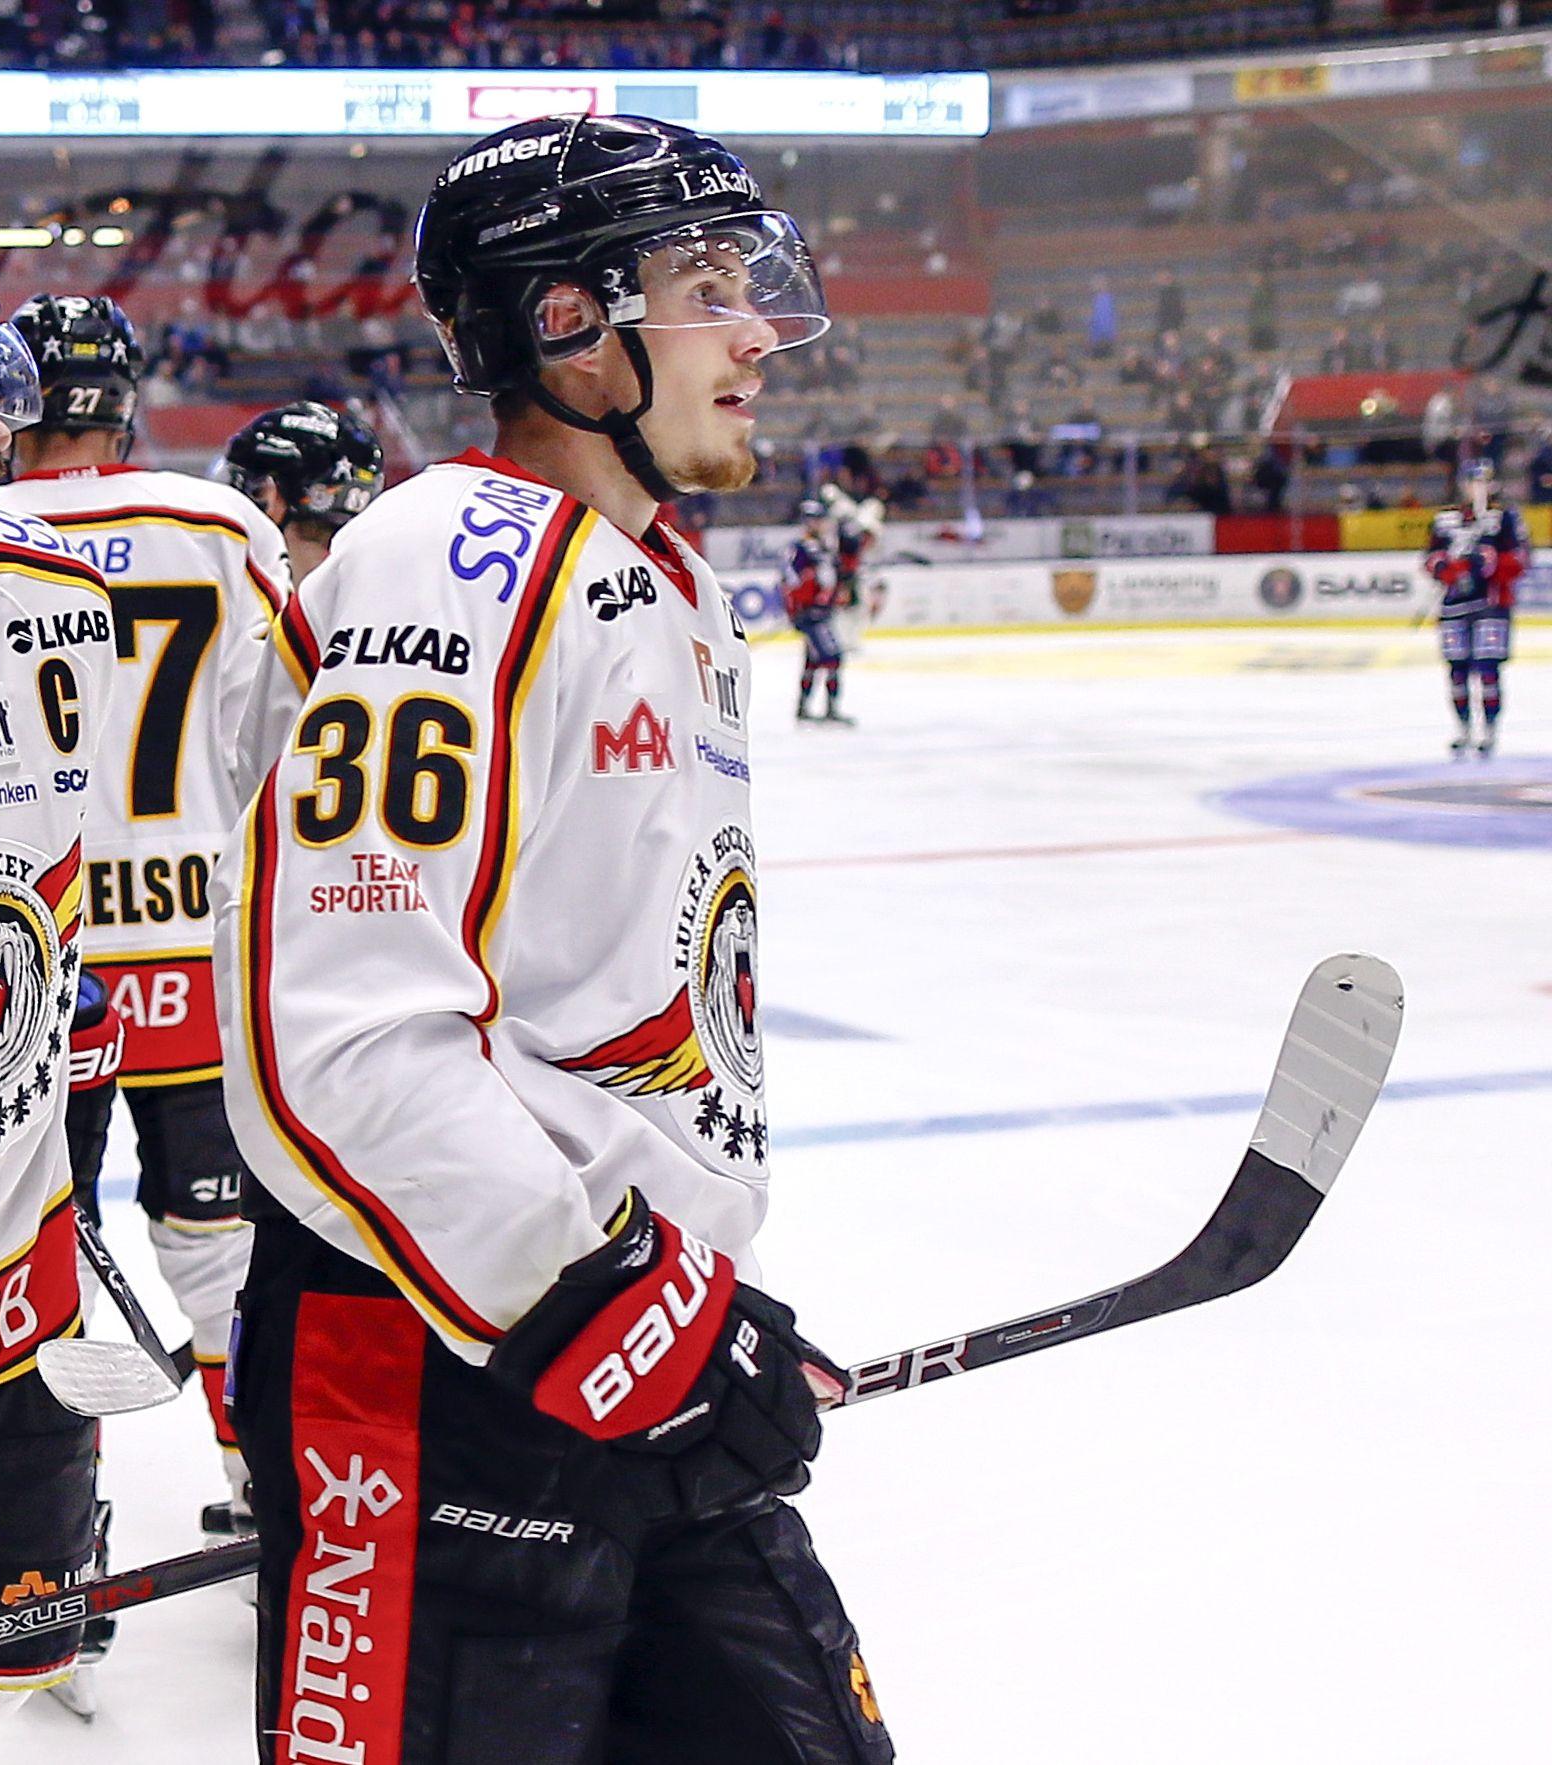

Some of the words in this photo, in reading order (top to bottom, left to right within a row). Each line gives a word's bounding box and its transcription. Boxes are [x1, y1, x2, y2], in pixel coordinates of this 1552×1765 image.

[447, 133, 562, 184] vinter.
[67, 387, 102, 415] 27
[450, 477, 553, 603] SSAB
[36, 609, 111, 651] LKAB
[354, 625, 470, 676] LKAB
[38, 656, 82, 756] C
[112, 581, 222, 821] 7
[591, 697, 677, 774] MAX
[290, 690, 479, 851] 36
[86, 852, 221, 927] ELSO
[310, 883, 430, 914] SPORTIA
[109, 970, 190, 1029] AB
[429, 1503, 576, 1545] BAUER
